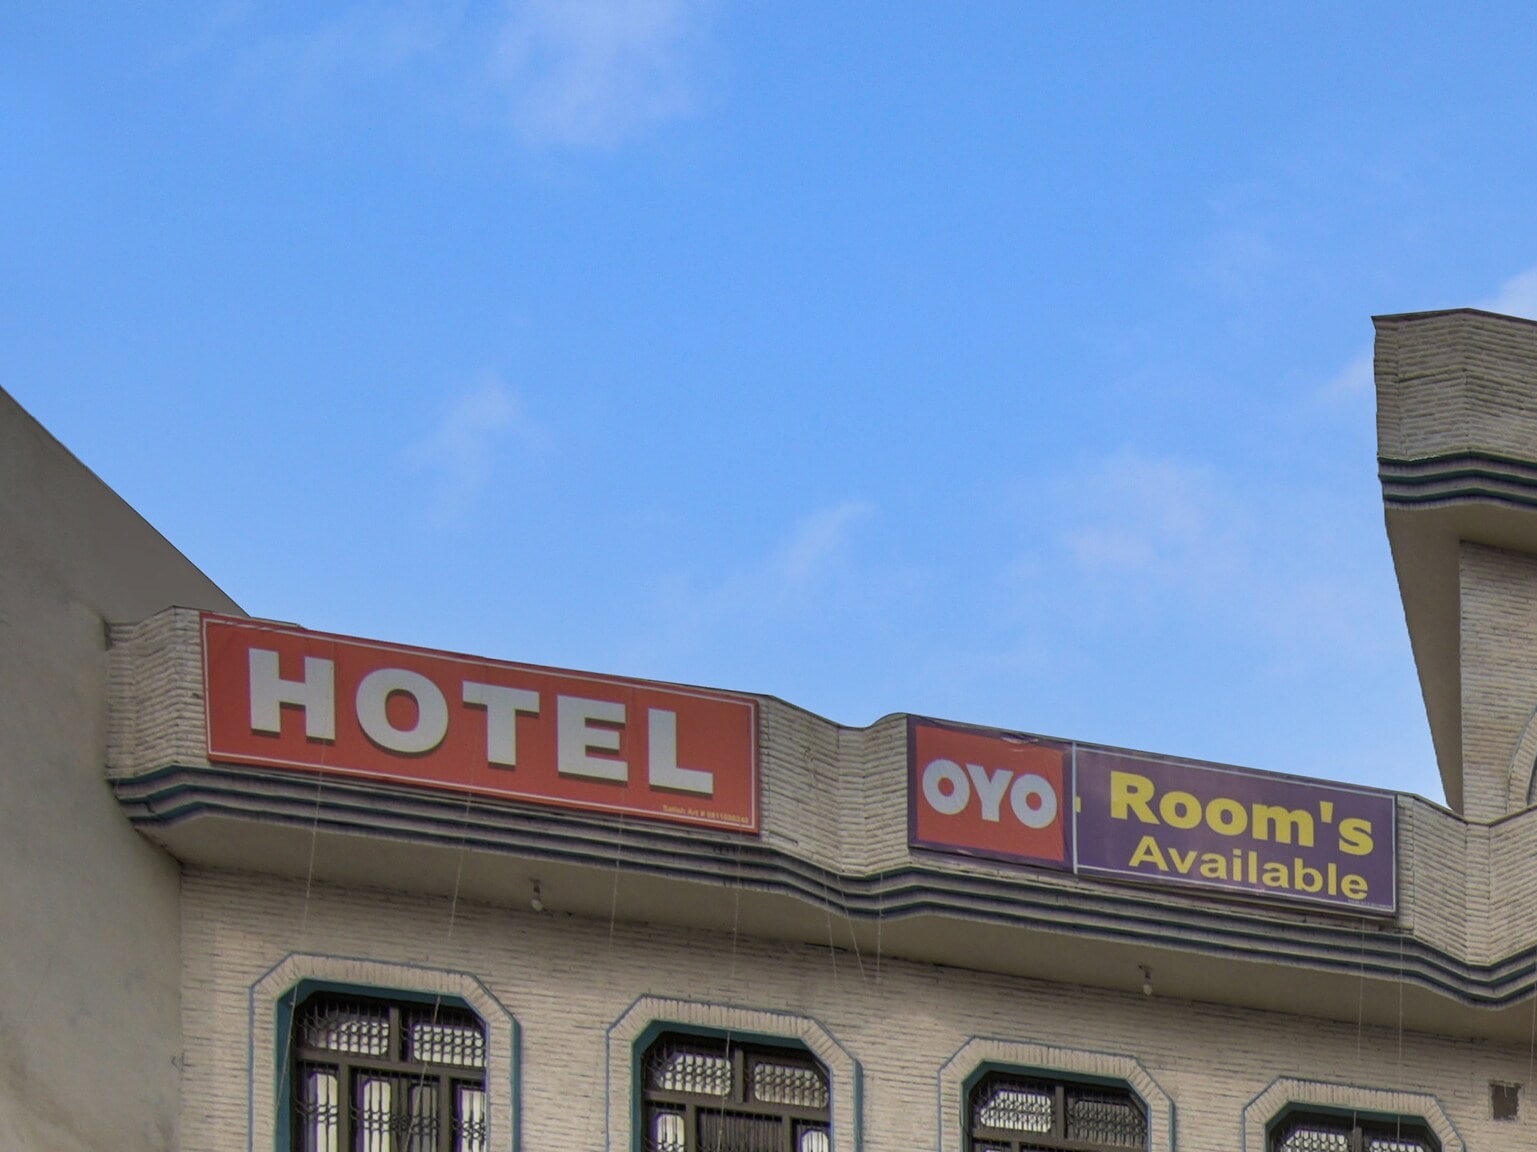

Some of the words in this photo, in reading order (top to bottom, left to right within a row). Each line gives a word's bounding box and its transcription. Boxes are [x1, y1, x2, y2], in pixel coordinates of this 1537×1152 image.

[247, 647, 714, 795] HOTEL
[922, 759, 1057, 828] OYO
[1110, 771, 1374, 856] Room's
[1129, 835, 1369, 900] Available
